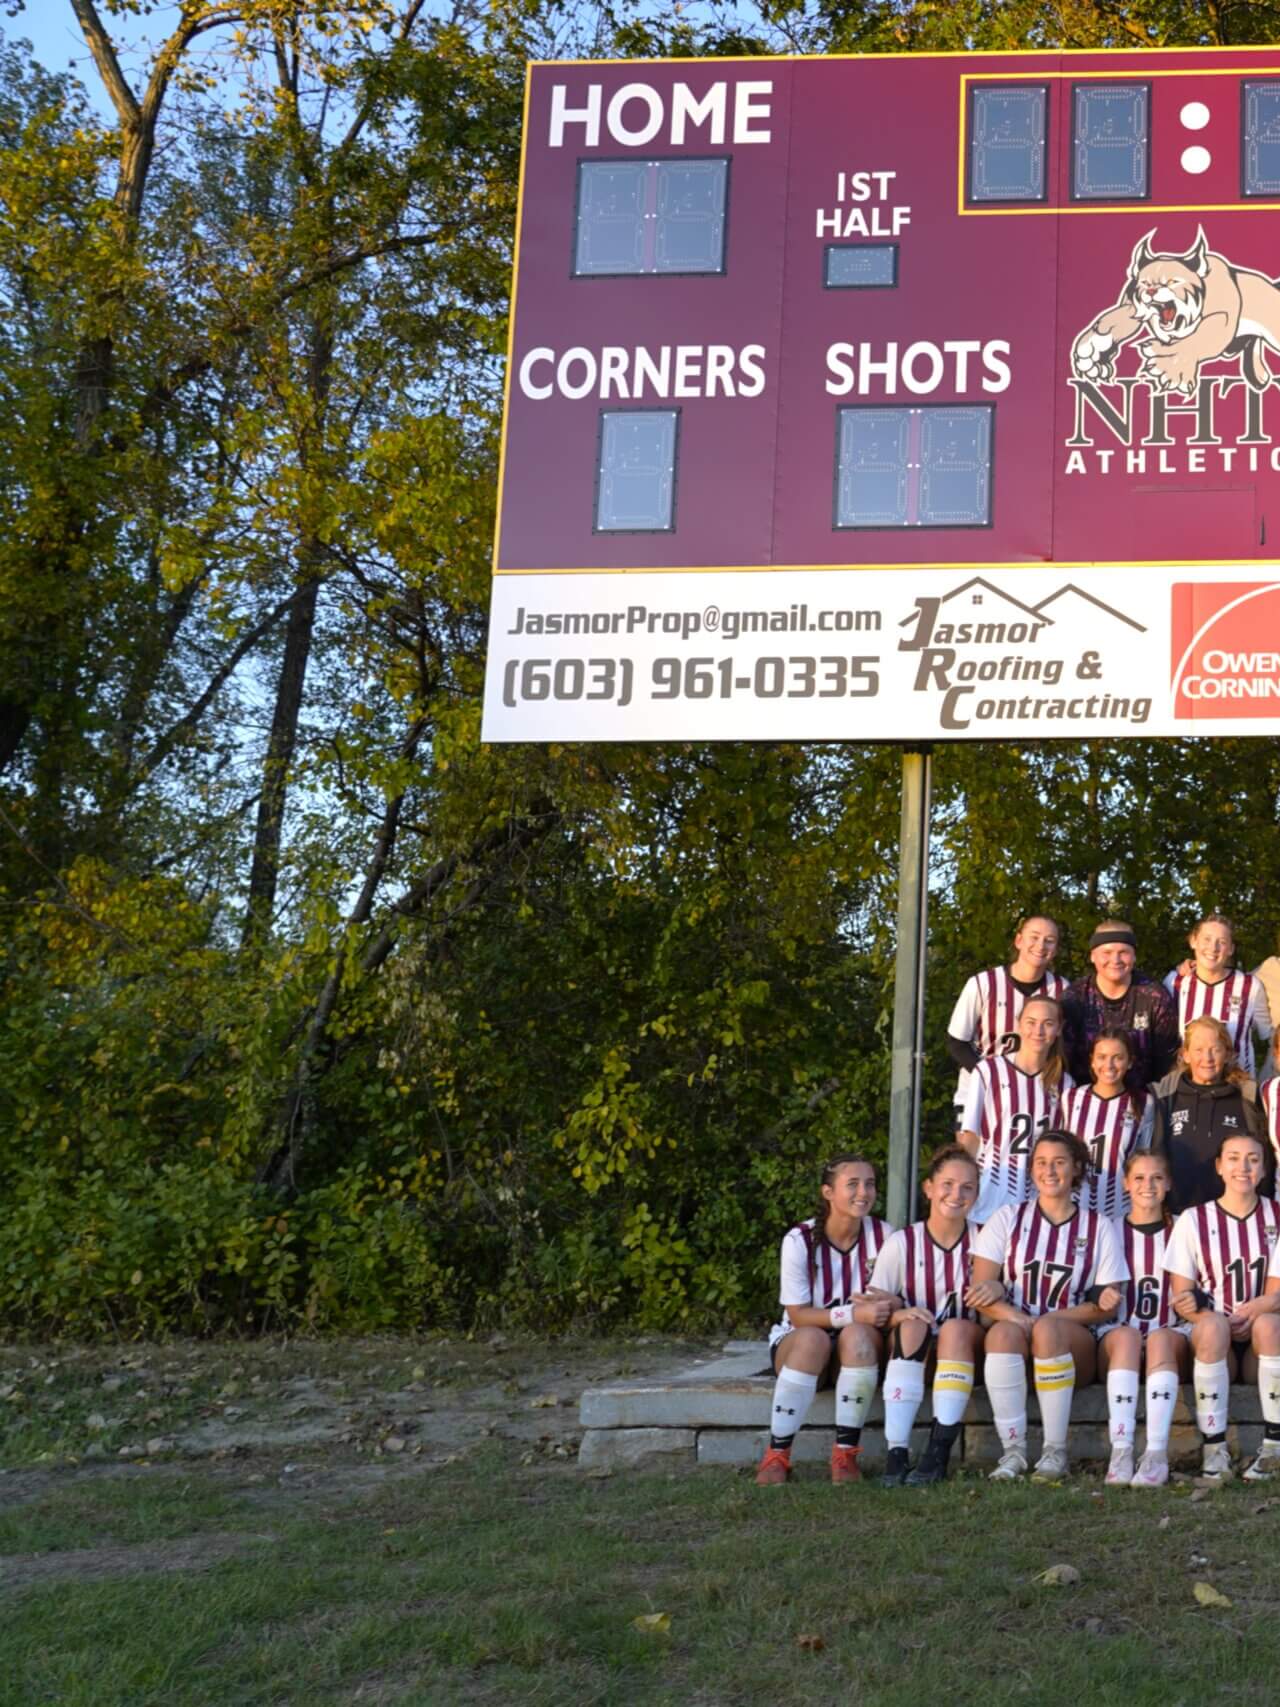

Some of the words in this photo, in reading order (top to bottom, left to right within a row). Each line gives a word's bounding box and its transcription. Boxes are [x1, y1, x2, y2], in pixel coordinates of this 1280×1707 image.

[548, 80, 773, 148] HOME
[815, 206, 911, 238] HALF
[517, 343, 766, 401] CORNERS
[825, 339, 1012, 396] SHOTS
[507, 604, 882, 641] JasmorProp@gmail.com
[898, 597, 1047, 651] Jasmor
[502, 658, 634, 708] (603)
[651, 655, 881, 700] 961-0335
[913, 648, 1064, 691] Roofing
[1076, 650, 1103, 680] &
[939, 685, 1153, 730] Contracting
[1022, 1258, 1074, 1309] 17
[1135, 1275, 1161, 1321] 6
[1227, 1255, 1267, 1304] 11
